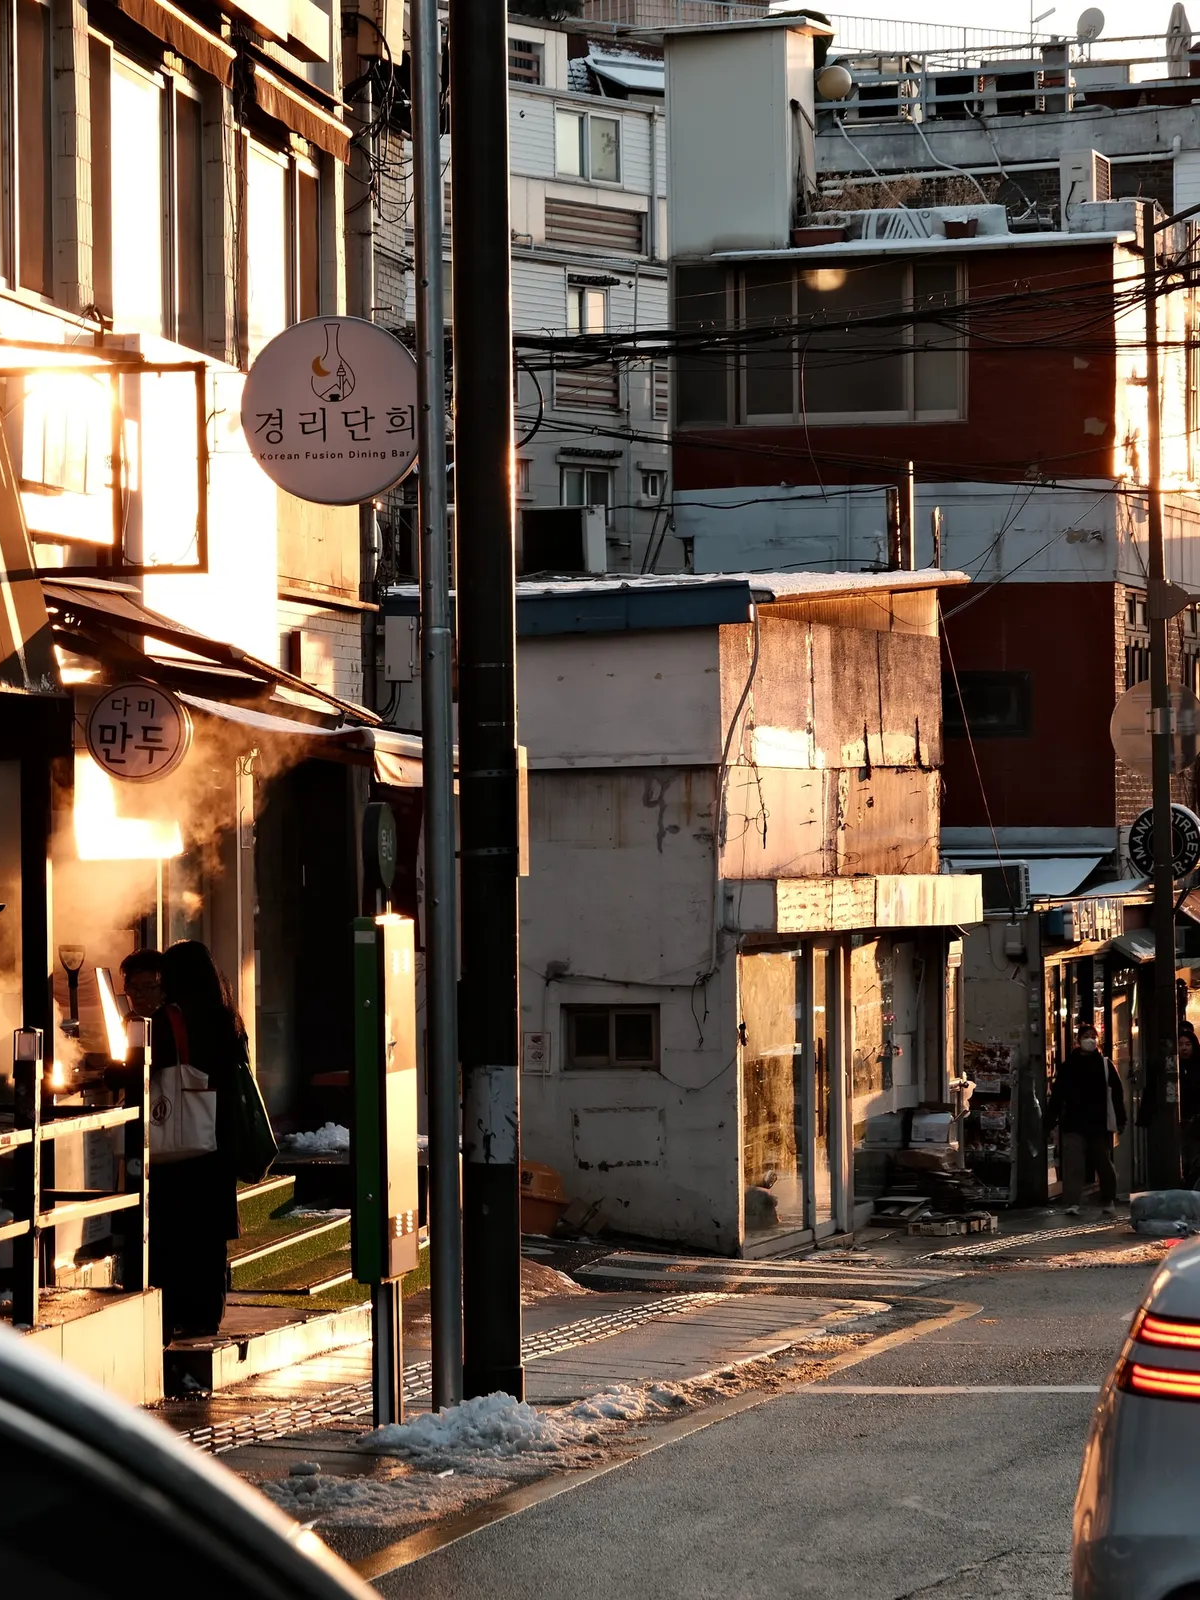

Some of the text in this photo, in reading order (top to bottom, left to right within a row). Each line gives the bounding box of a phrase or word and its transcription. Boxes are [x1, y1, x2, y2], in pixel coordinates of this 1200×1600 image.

[254, 404, 416, 445] 경리단희
[259, 449, 411, 461] Korean Fusion Dining Bar
[111, 696, 155, 719] 다미
[98, 721, 169, 764] 만두
[1132, 813, 1154, 860] MANI
